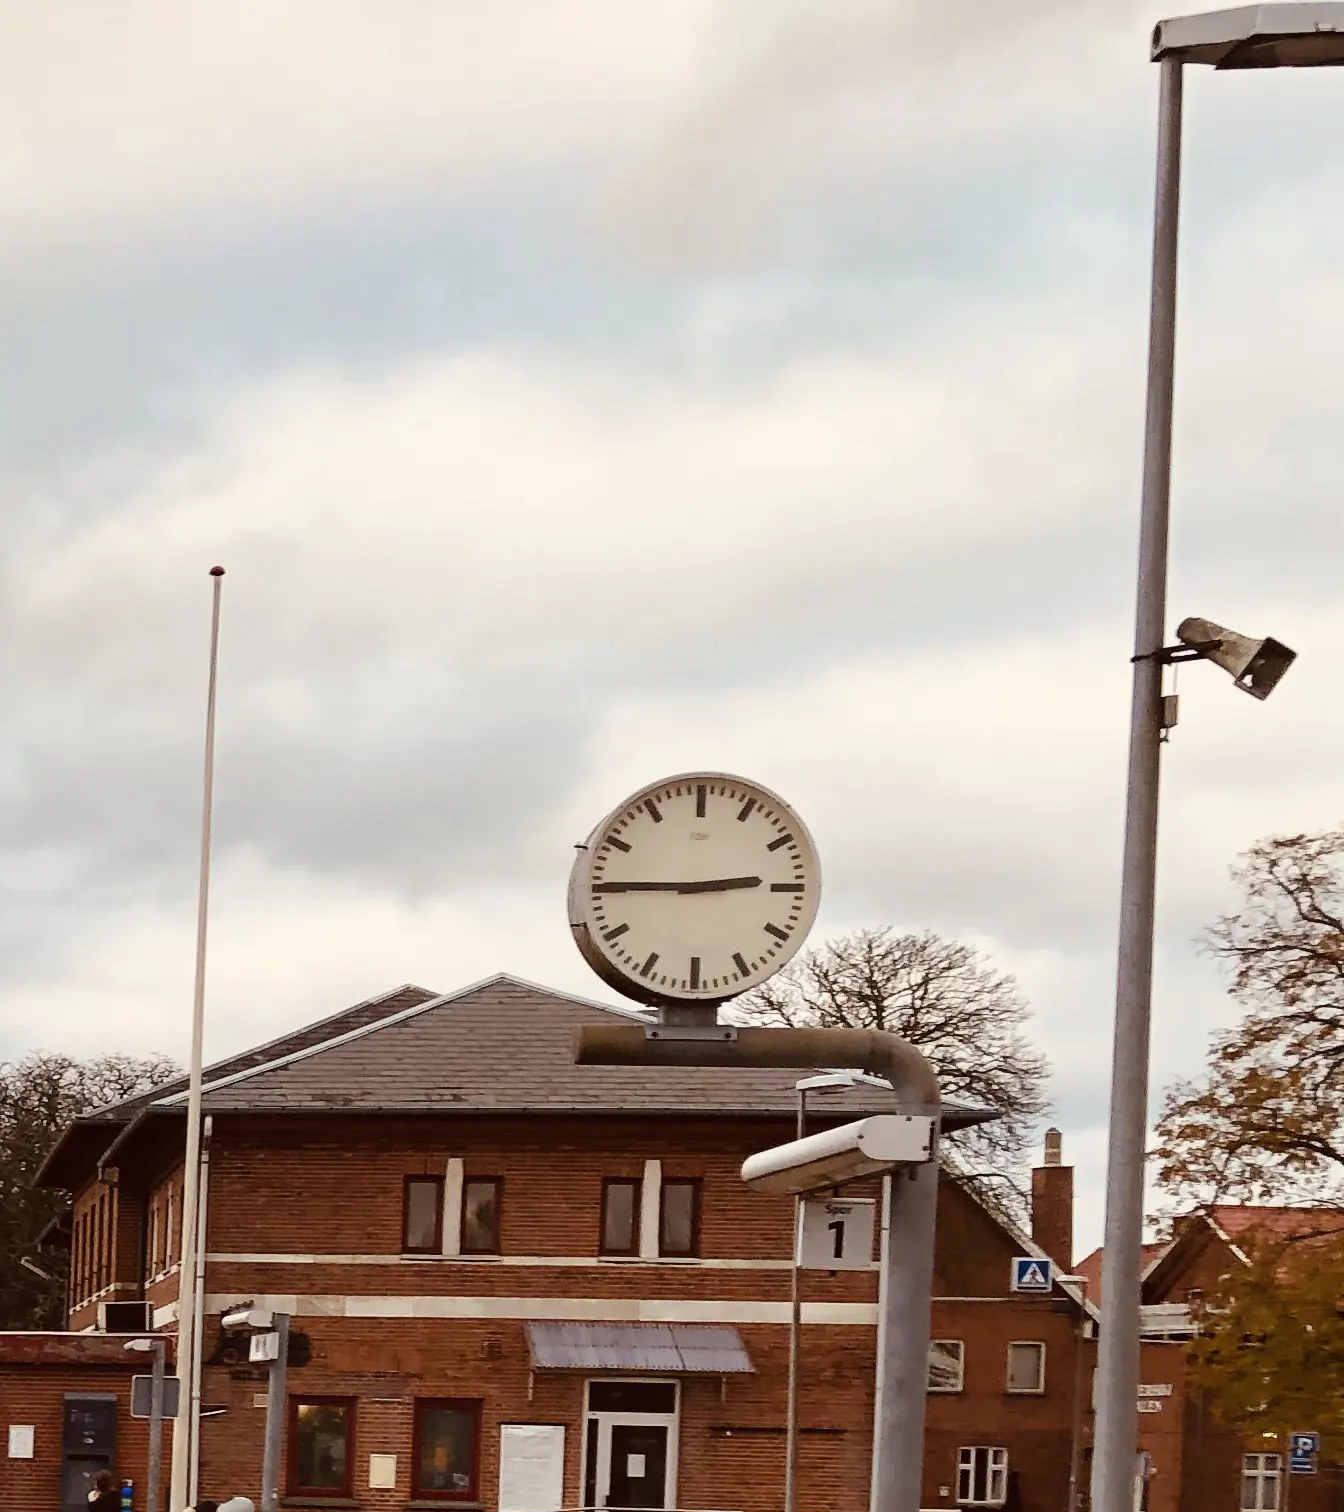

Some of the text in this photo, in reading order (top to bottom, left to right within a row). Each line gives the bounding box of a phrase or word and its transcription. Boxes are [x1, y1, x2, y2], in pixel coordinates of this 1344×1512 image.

[824, 1204, 854, 1219] Spor
[827, 1220, 845, 1259] 1
[1296, 1437, 1313, 1457] P
